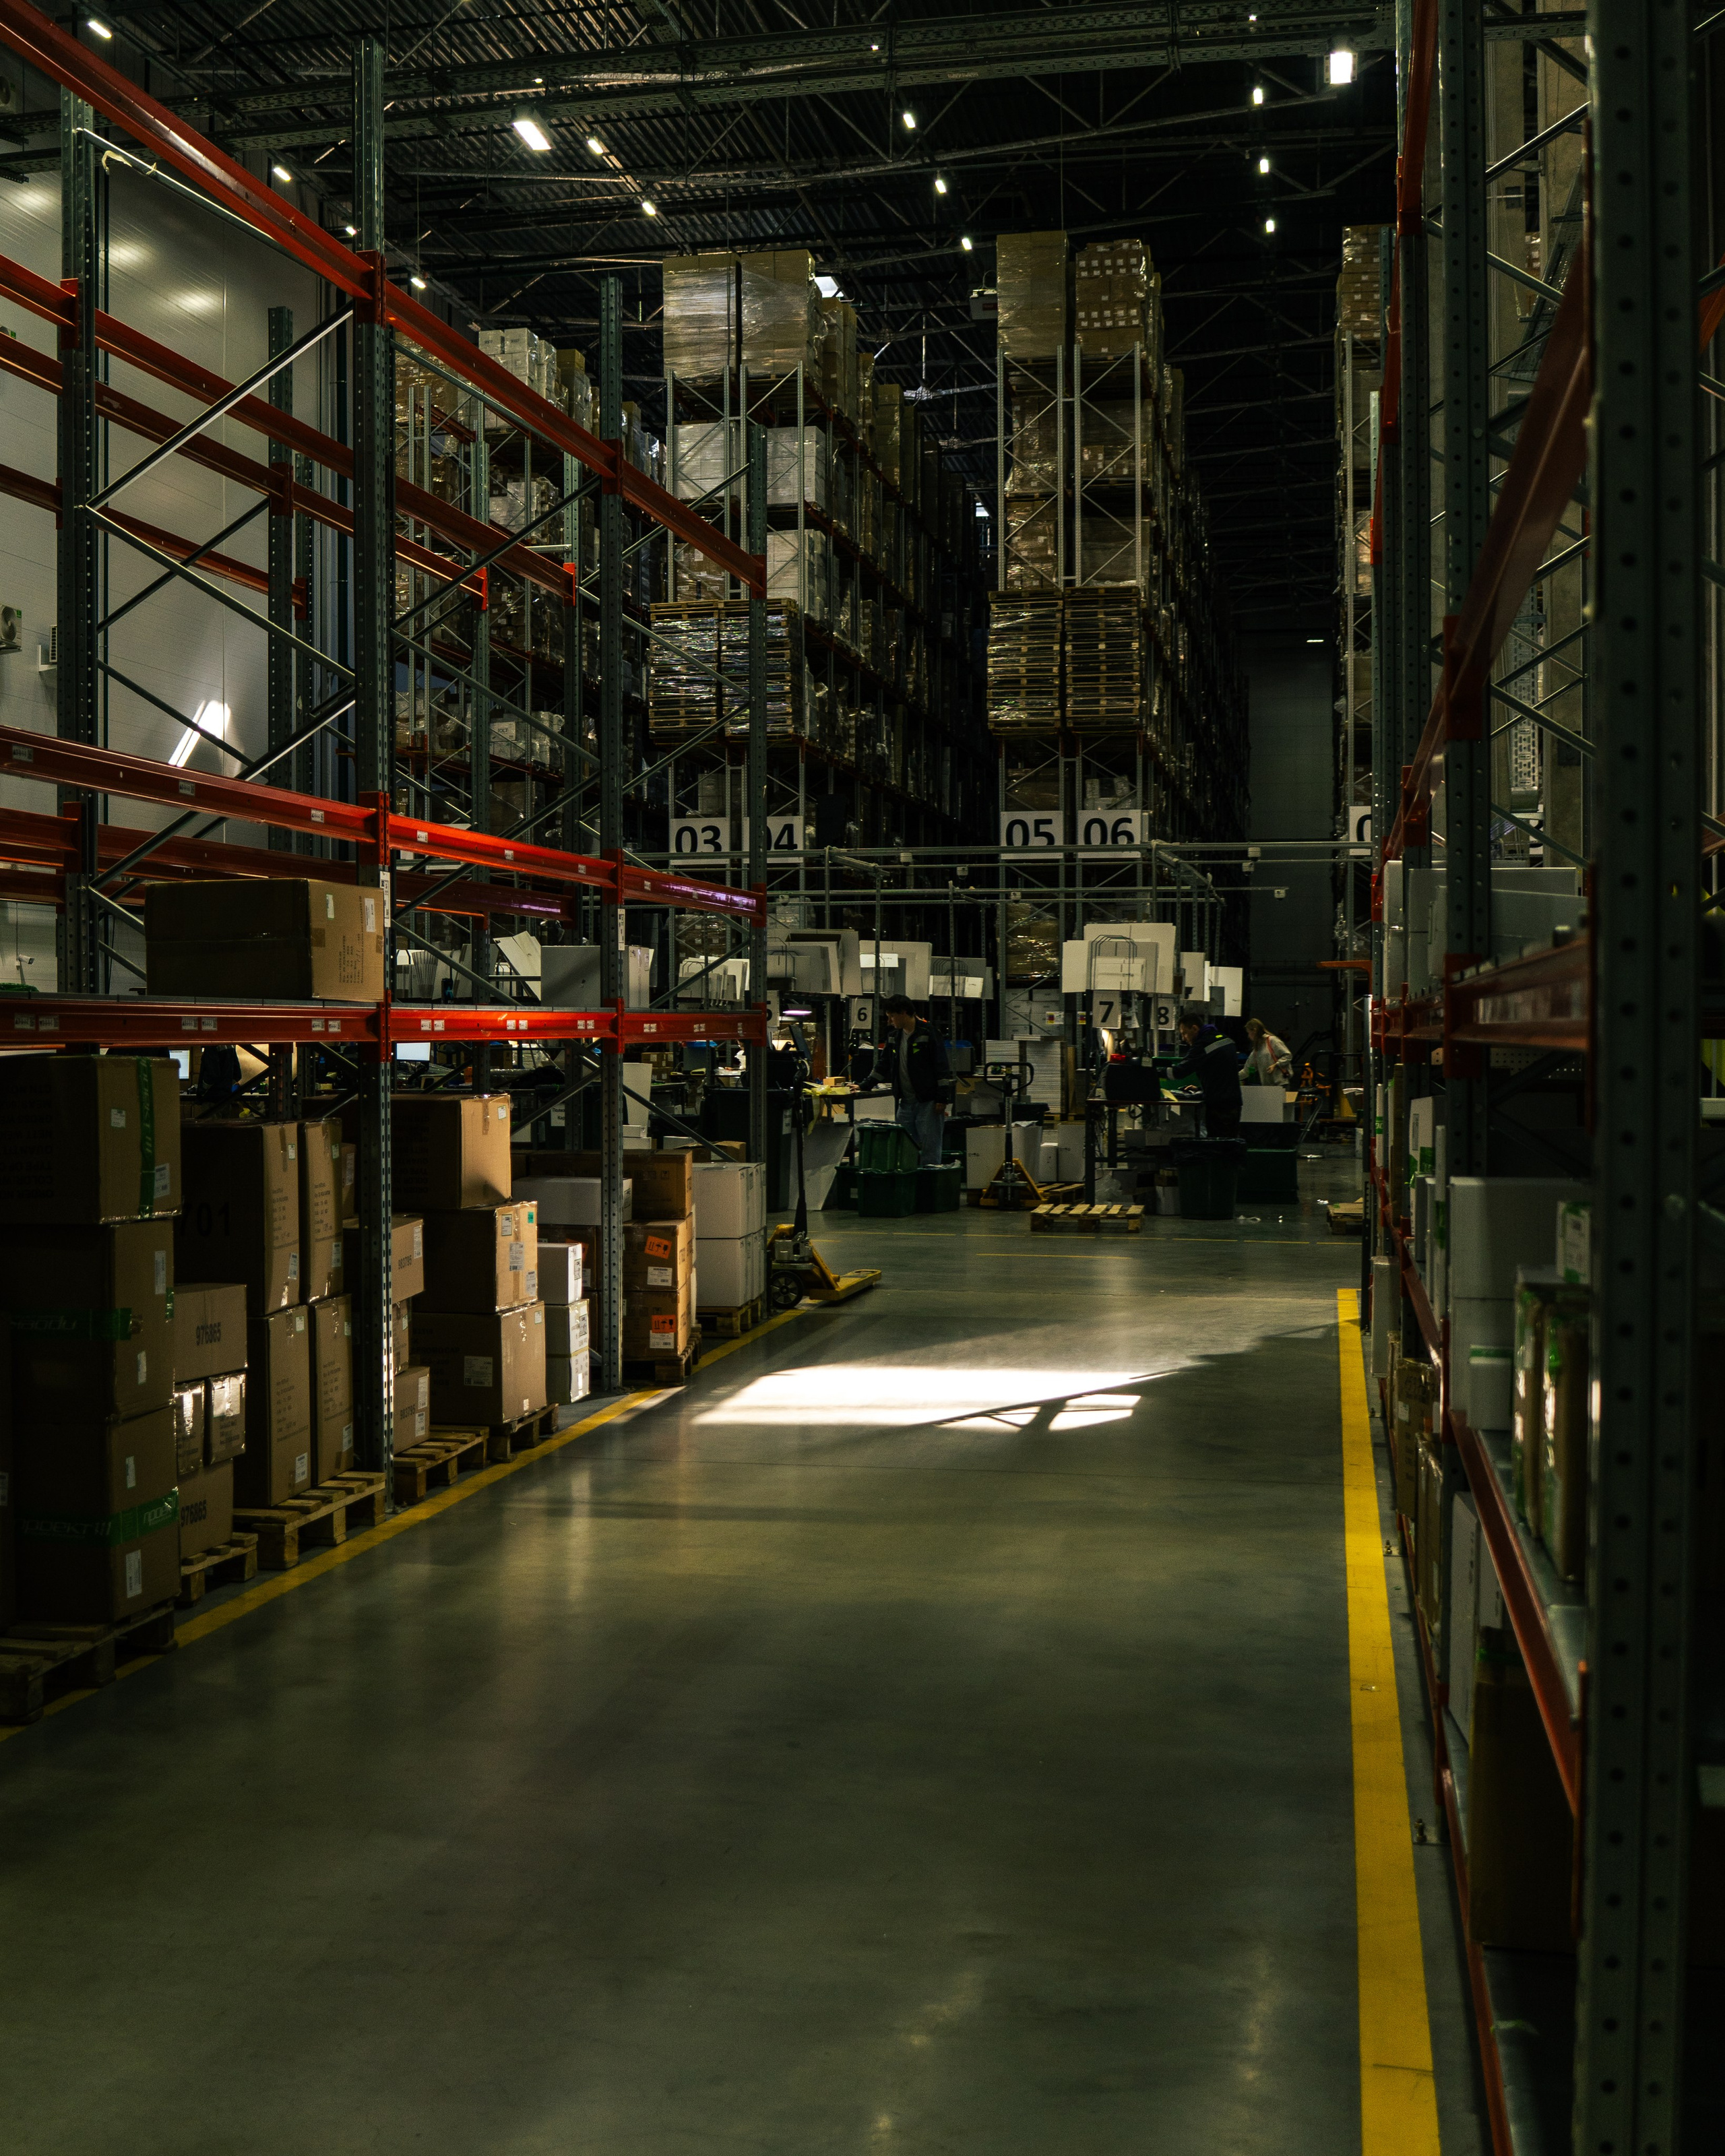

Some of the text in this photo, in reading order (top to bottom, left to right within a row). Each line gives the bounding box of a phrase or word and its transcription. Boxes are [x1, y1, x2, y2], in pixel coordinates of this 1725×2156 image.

[675, 825, 722, 852] 03
[766, 823, 798, 851] 4
[1005, 818, 1055, 846] 05
[1084, 817, 1135, 846] 06
[857, 1007, 867, 1022] 6
[1099, 1001, 1115, 1023] 7
[1158, 1006, 1169, 1025] 8
[17, 1114, 53, 1124] GROSS
[0, 1145, 53, 1155] QUANTIT
[9, 1162, 24, 1172] OF
[26, 1161, 52, 1171] TYPE
[17, 1189, 55, 1199] ORDER
[398, 1255, 412, 1270] 983795
[195, 1321, 222, 1346] 976865
[180, 1499, 207, 1527] 976865
